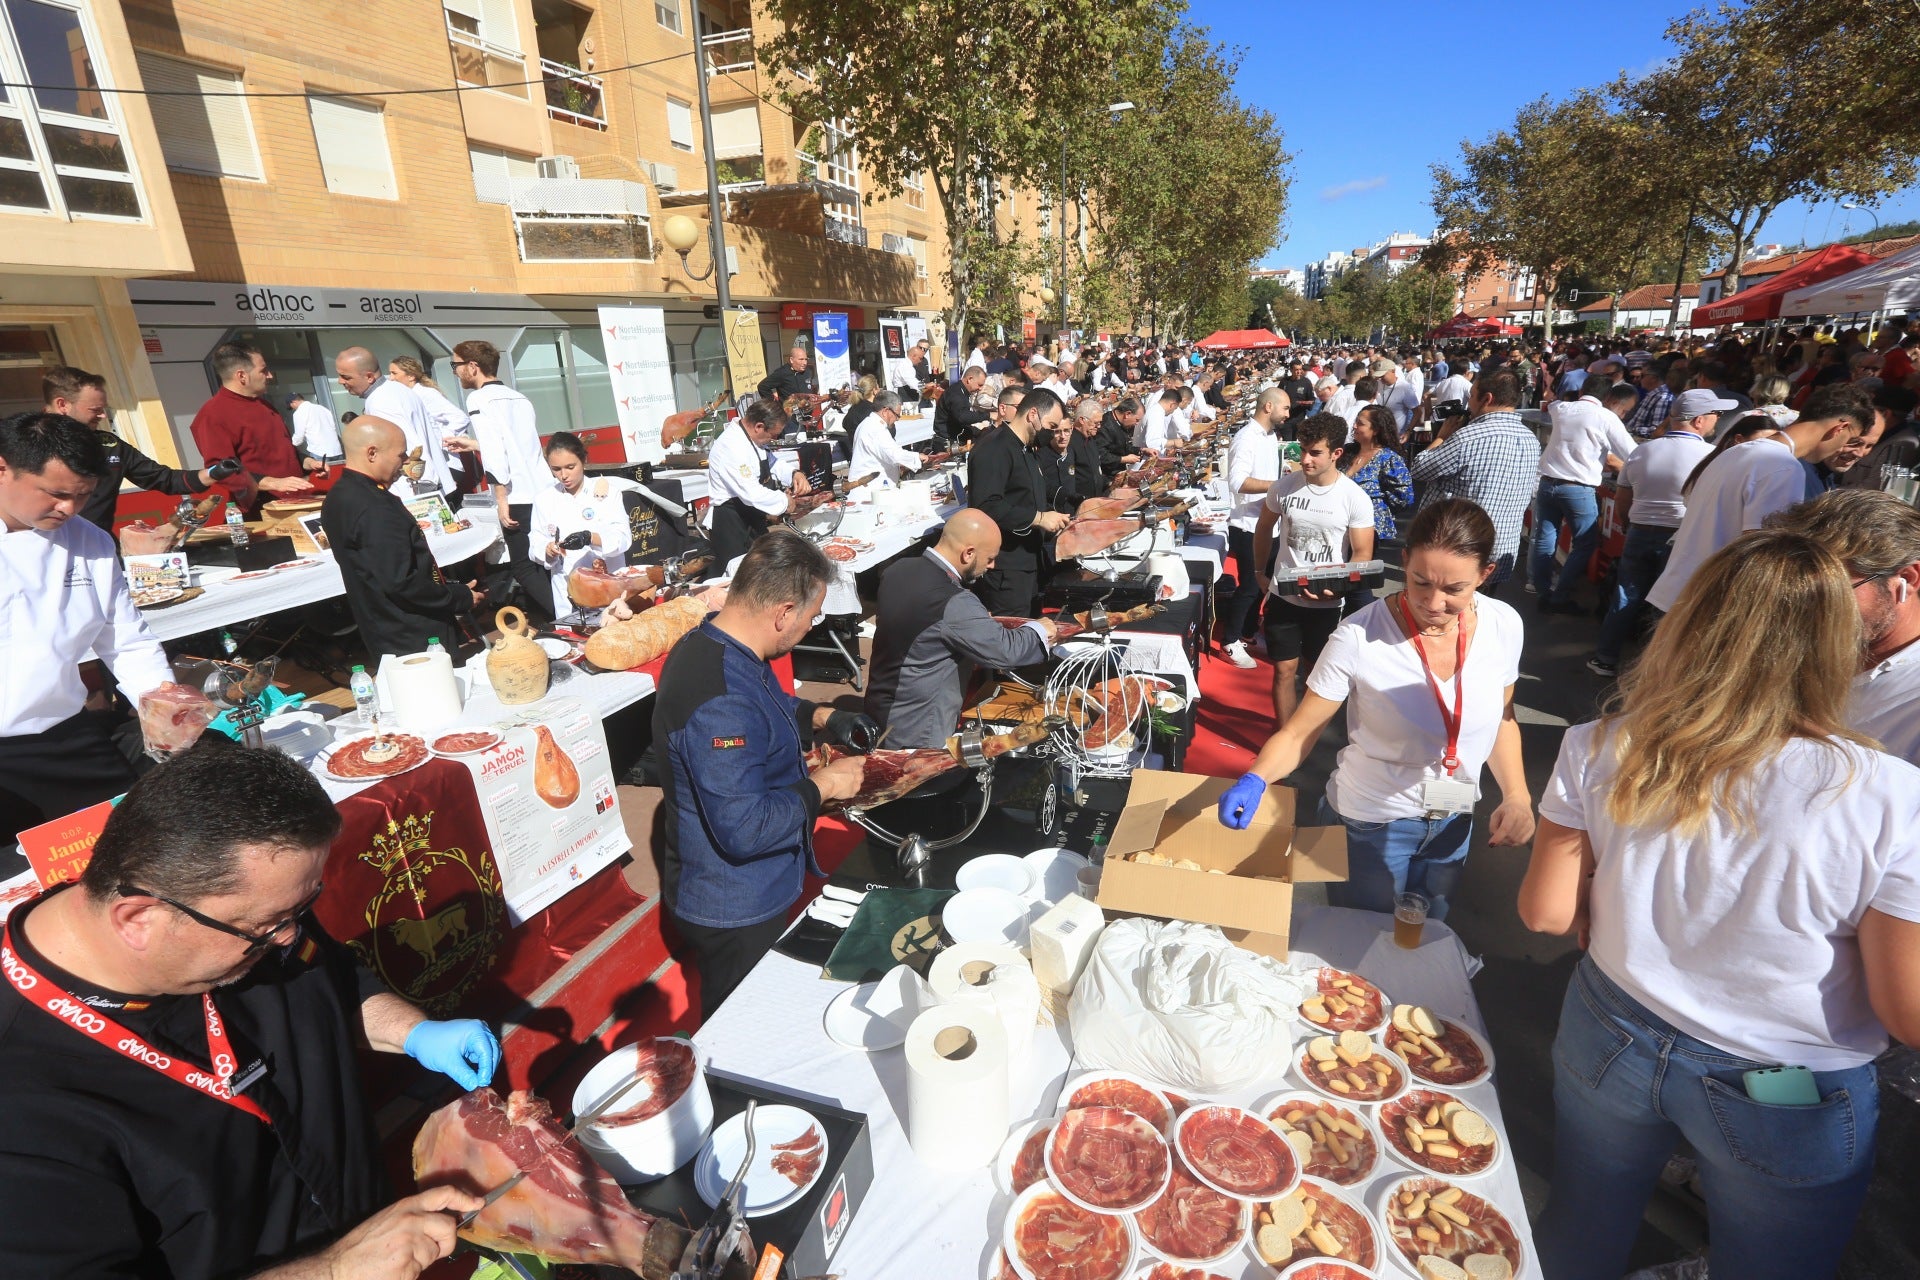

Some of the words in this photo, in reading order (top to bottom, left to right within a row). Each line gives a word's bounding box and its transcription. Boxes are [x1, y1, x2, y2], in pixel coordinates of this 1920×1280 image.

[235, 288, 315, 312] adhoc
[360, 294, 422, 313] arasol
[1709, 304, 1744, 320] Cruzcampo
[254, 313, 305, 321] ABOGADOS
[374, 314, 414, 322] ASESORES
[637, 428, 660, 440] NorteH
[713, 737, 744, 748] España
[480, 745, 526, 775] JAMÓN
[481, 773, 496, 783] DE
[494, 758, 528, 777] TERUEL
[48, 831, 102, 862] Jamó
[547, 846, 576, 873] ESTRELLA
[574, 828, 599, 851] IMPORTA
[46, 868, 70, 885] de
[68, 857, 90, 874] Te
[46, 998, 106, 1034] COVAP
[117, 1038, 171, 1070] COVAP
